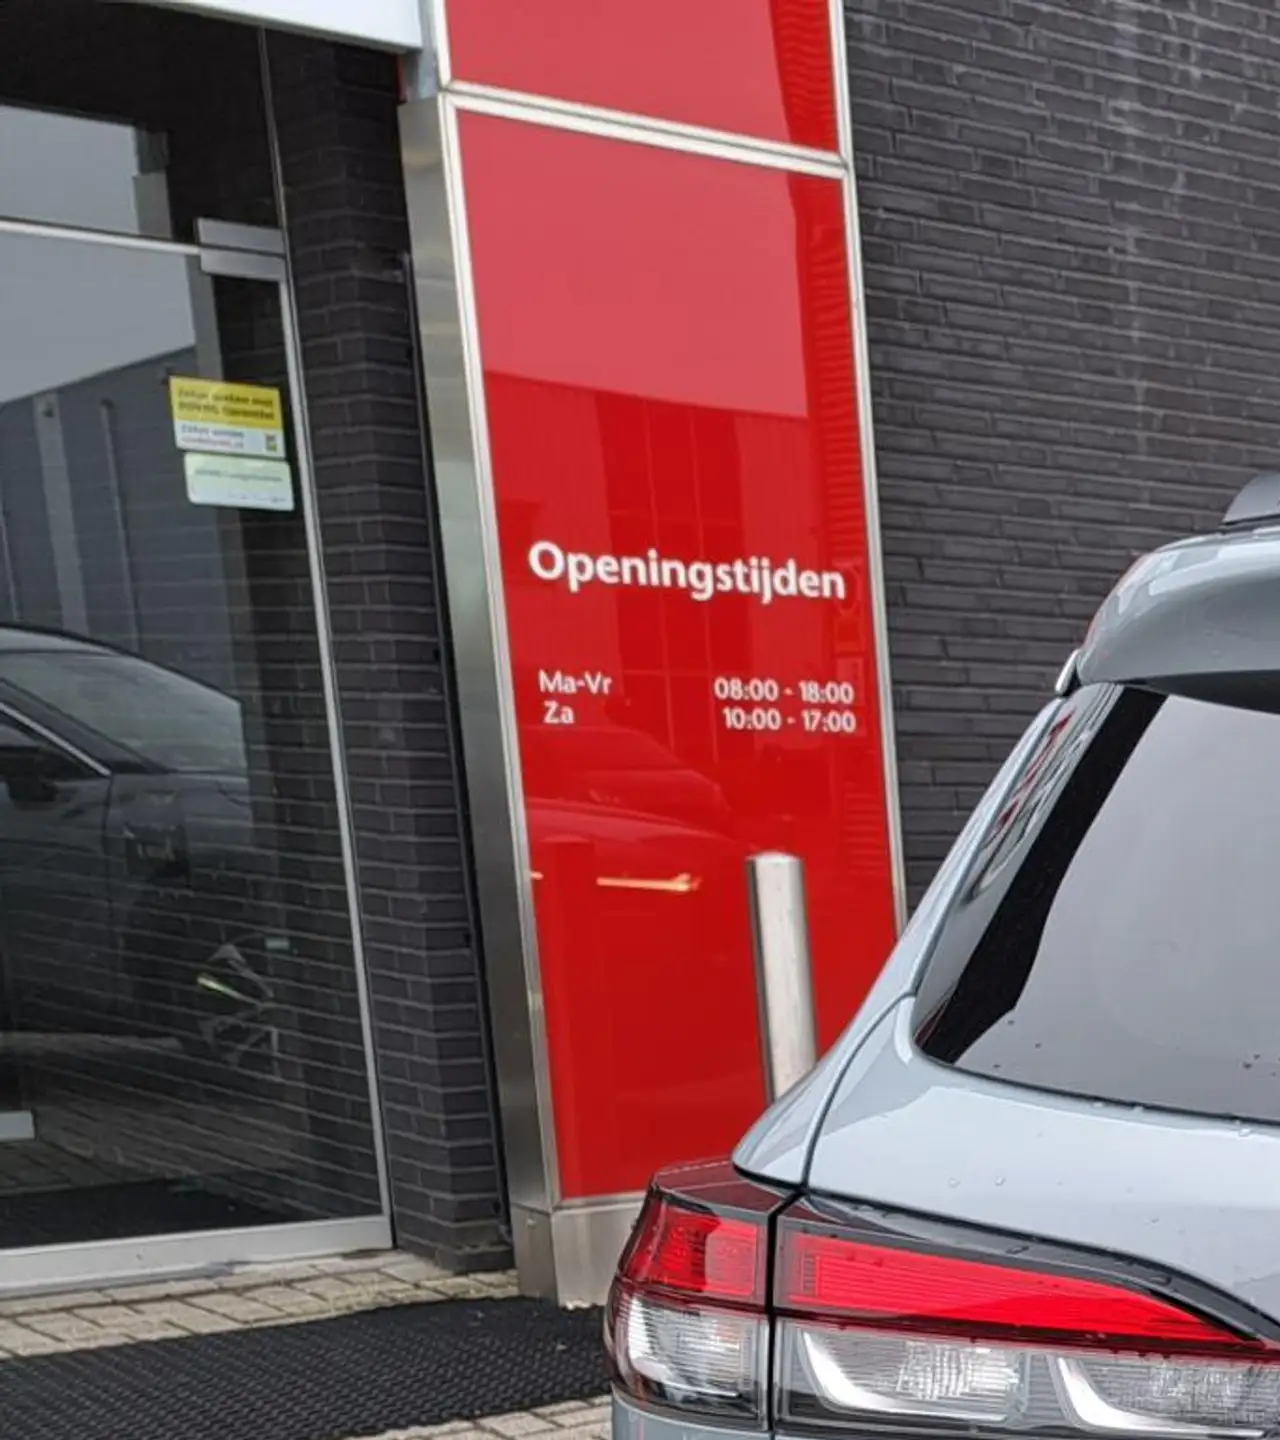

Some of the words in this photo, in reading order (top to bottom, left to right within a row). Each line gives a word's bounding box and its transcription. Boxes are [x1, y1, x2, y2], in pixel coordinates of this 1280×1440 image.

[528, 540, 846, 604] Openingstijden
[538, 668, 613, 695] Ma-Vr
[714, 676, 779, 702] 08:00
[798, 679, 855, 704] 18:00
[543, 699, 575, 725] Za
[722, 706, 782, 731] 10:00
[801, 708, 857, 733] 17:00
